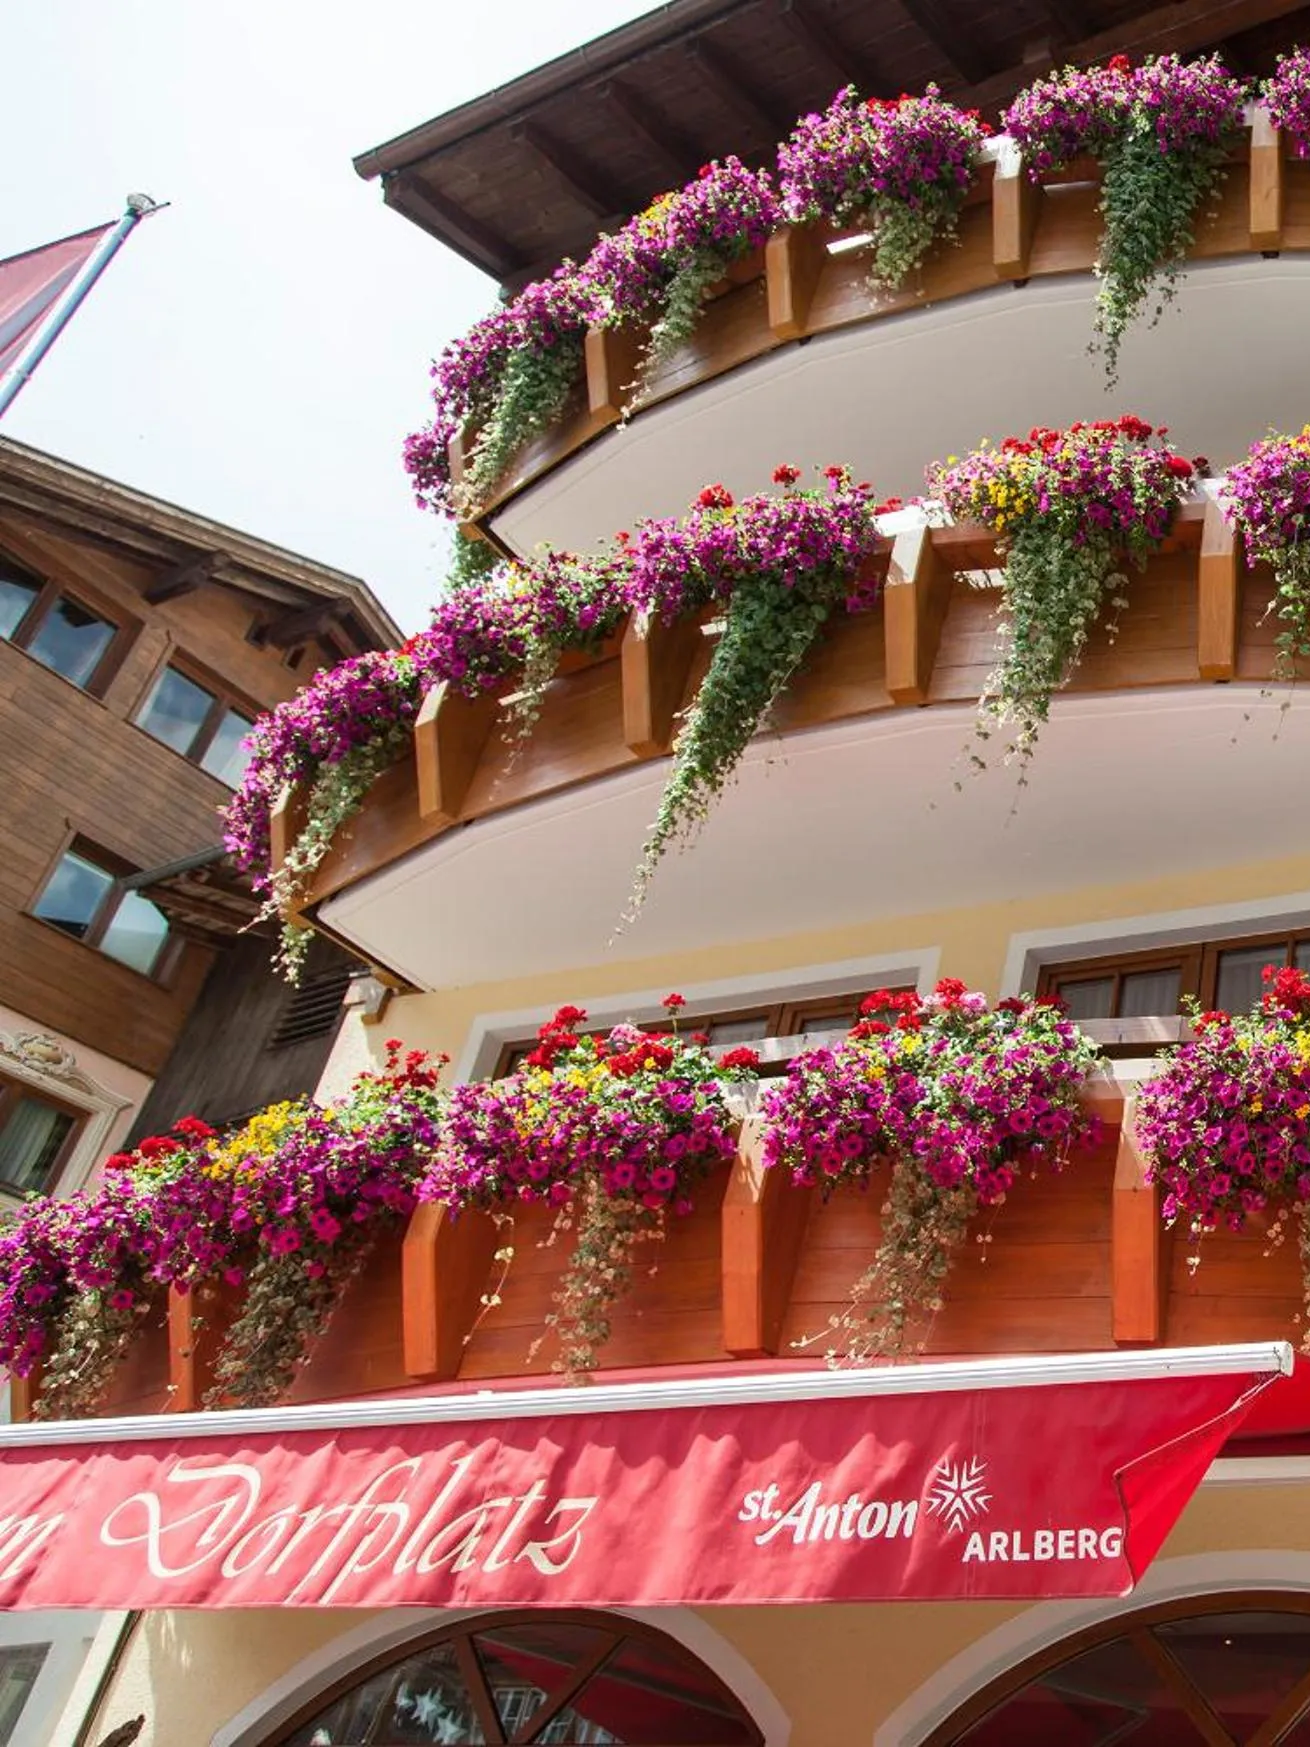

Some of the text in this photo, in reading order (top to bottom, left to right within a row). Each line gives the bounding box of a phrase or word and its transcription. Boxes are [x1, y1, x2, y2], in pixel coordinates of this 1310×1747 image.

[0, 1453, 599, 1605] m Dorfplatz
[962, 1527, 1123, 1563] ARLBERG
